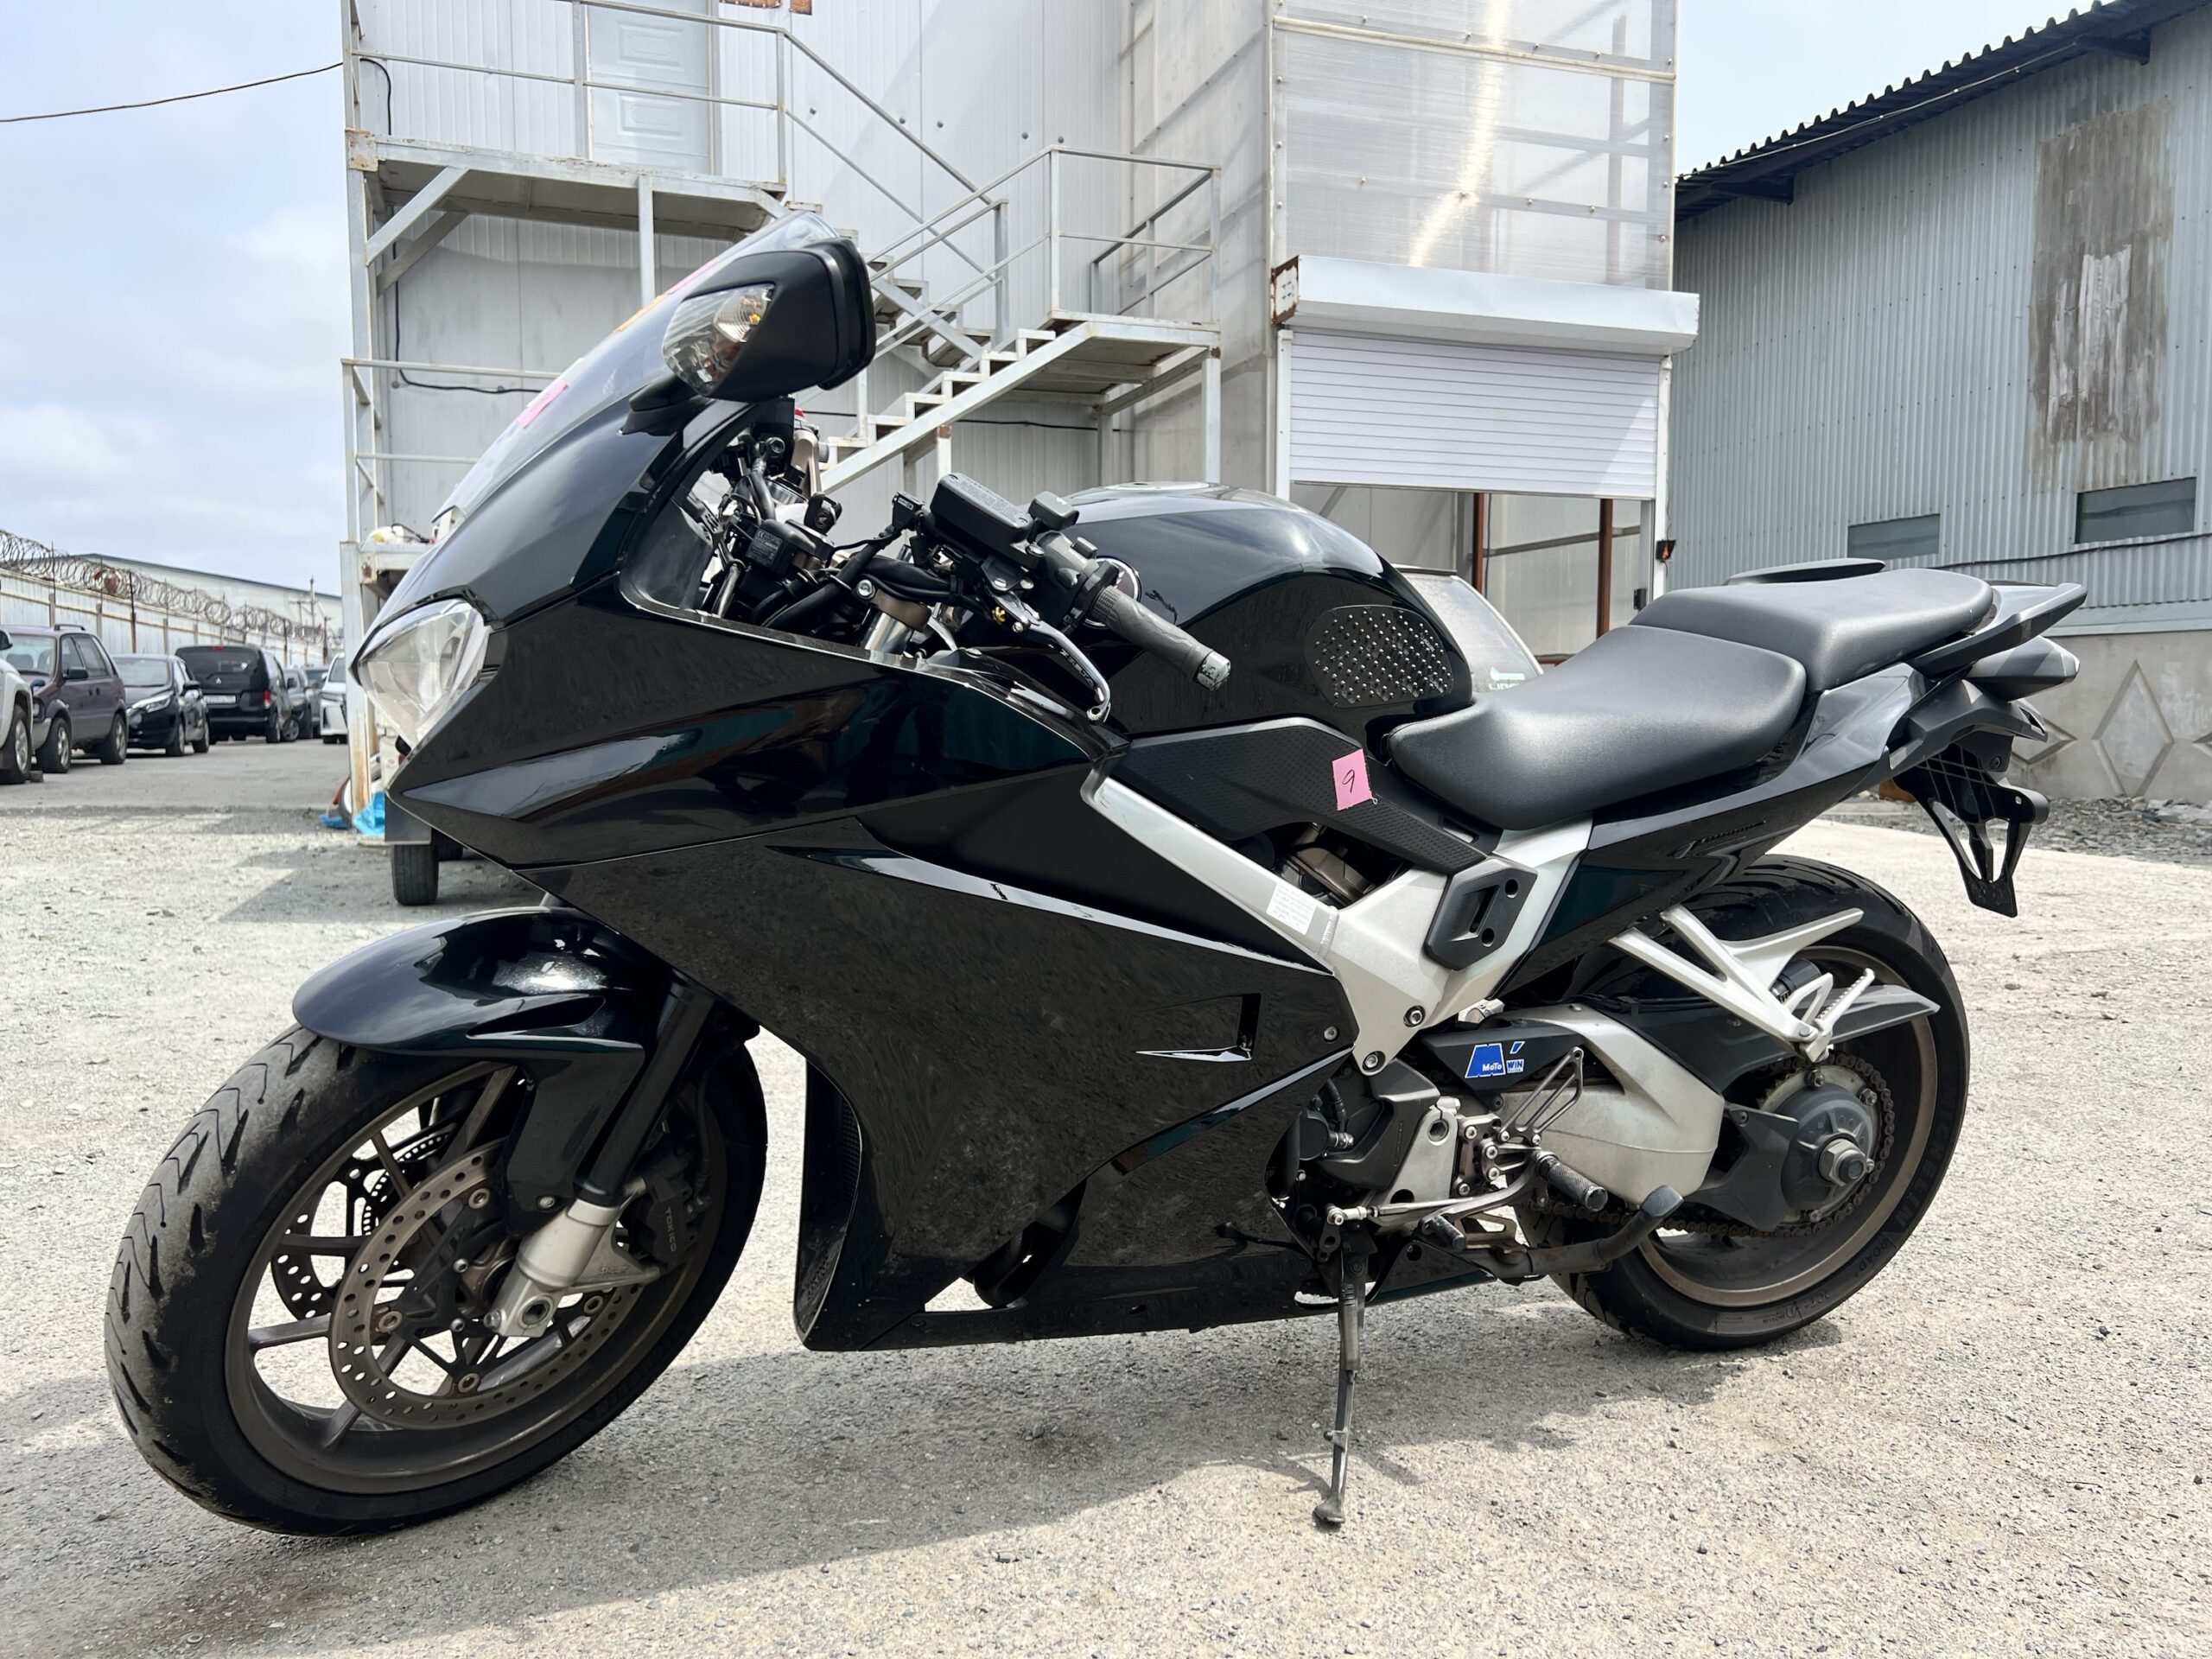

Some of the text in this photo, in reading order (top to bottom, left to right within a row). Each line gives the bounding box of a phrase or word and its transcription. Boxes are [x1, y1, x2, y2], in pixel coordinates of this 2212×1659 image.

[1342, 769, 1356, 793] 9
[1507, 1060, 1522, 1070] WIN
[1895, 1084, 1957, 1228] MICHELIN
[664, 1207, 676, 1253] TOKICO
